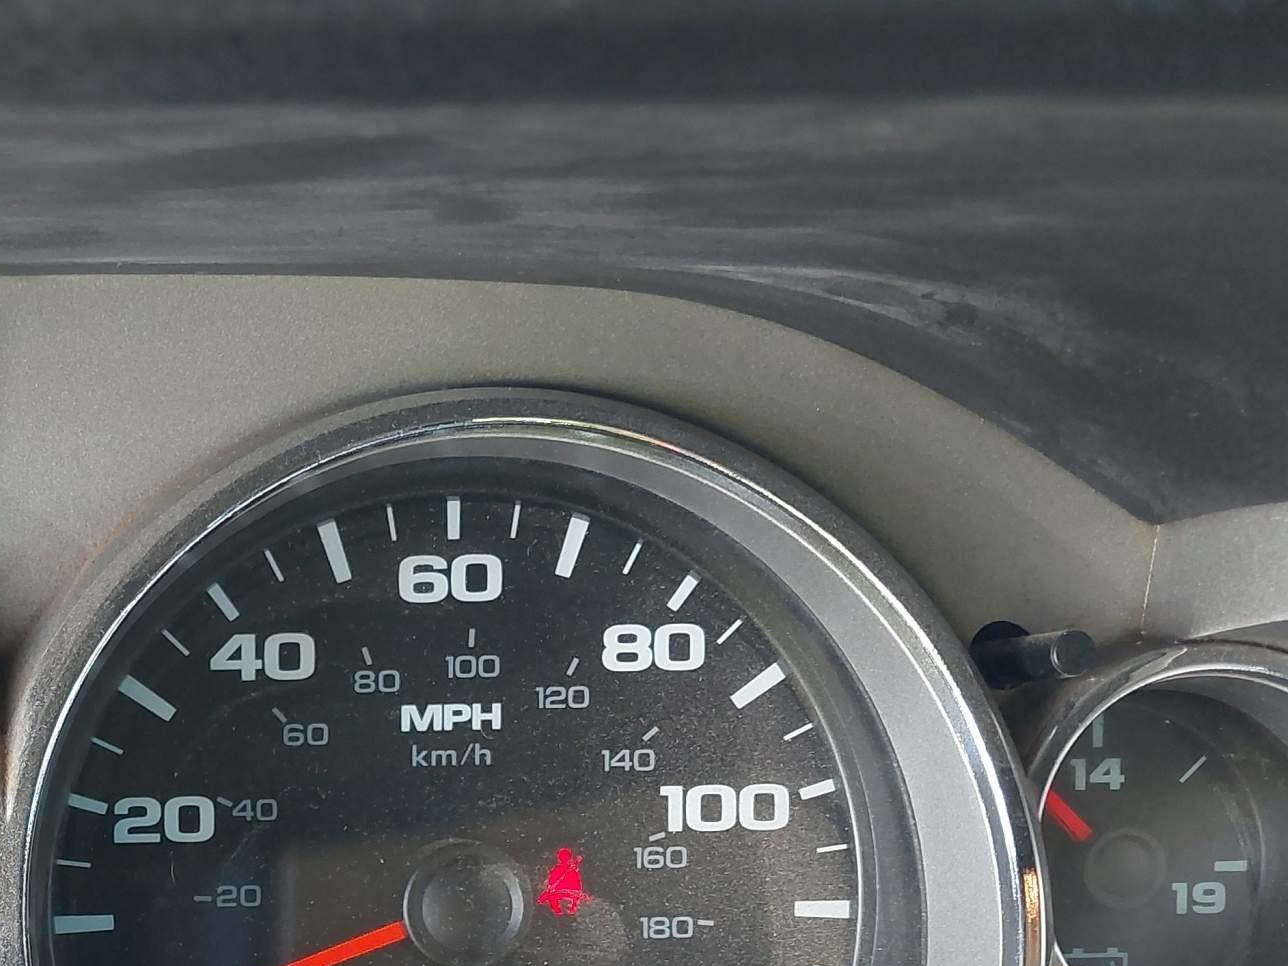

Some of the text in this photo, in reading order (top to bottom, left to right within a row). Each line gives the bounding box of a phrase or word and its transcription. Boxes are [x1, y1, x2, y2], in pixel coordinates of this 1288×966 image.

[398, 553, 503, 604] 60
[210, 632, 316, 681] 40
[601, 623, 705, 672] 80
[445, 654, 500, 679] 100
[353, 669, 401, 694] 80
[535, 686, 590, 710] 120
[400, 702, 502, 732] MPH
[282, 722, 329, 746] 60
[411, 743, 492, 768] km/h
[601, 748, 656, 773] 140
[1070, 757, 1126, 791] 14
[113, 796, 215, 844] 20
[231, 798, 278, 821] 40
[660, 783, 790, 832] 100
[634, 845, 688, 869] 160
[216, 884, 262, 908] 20
[1170, 881, 1227, 914] 19
[640, 916, 694, 940] 180
